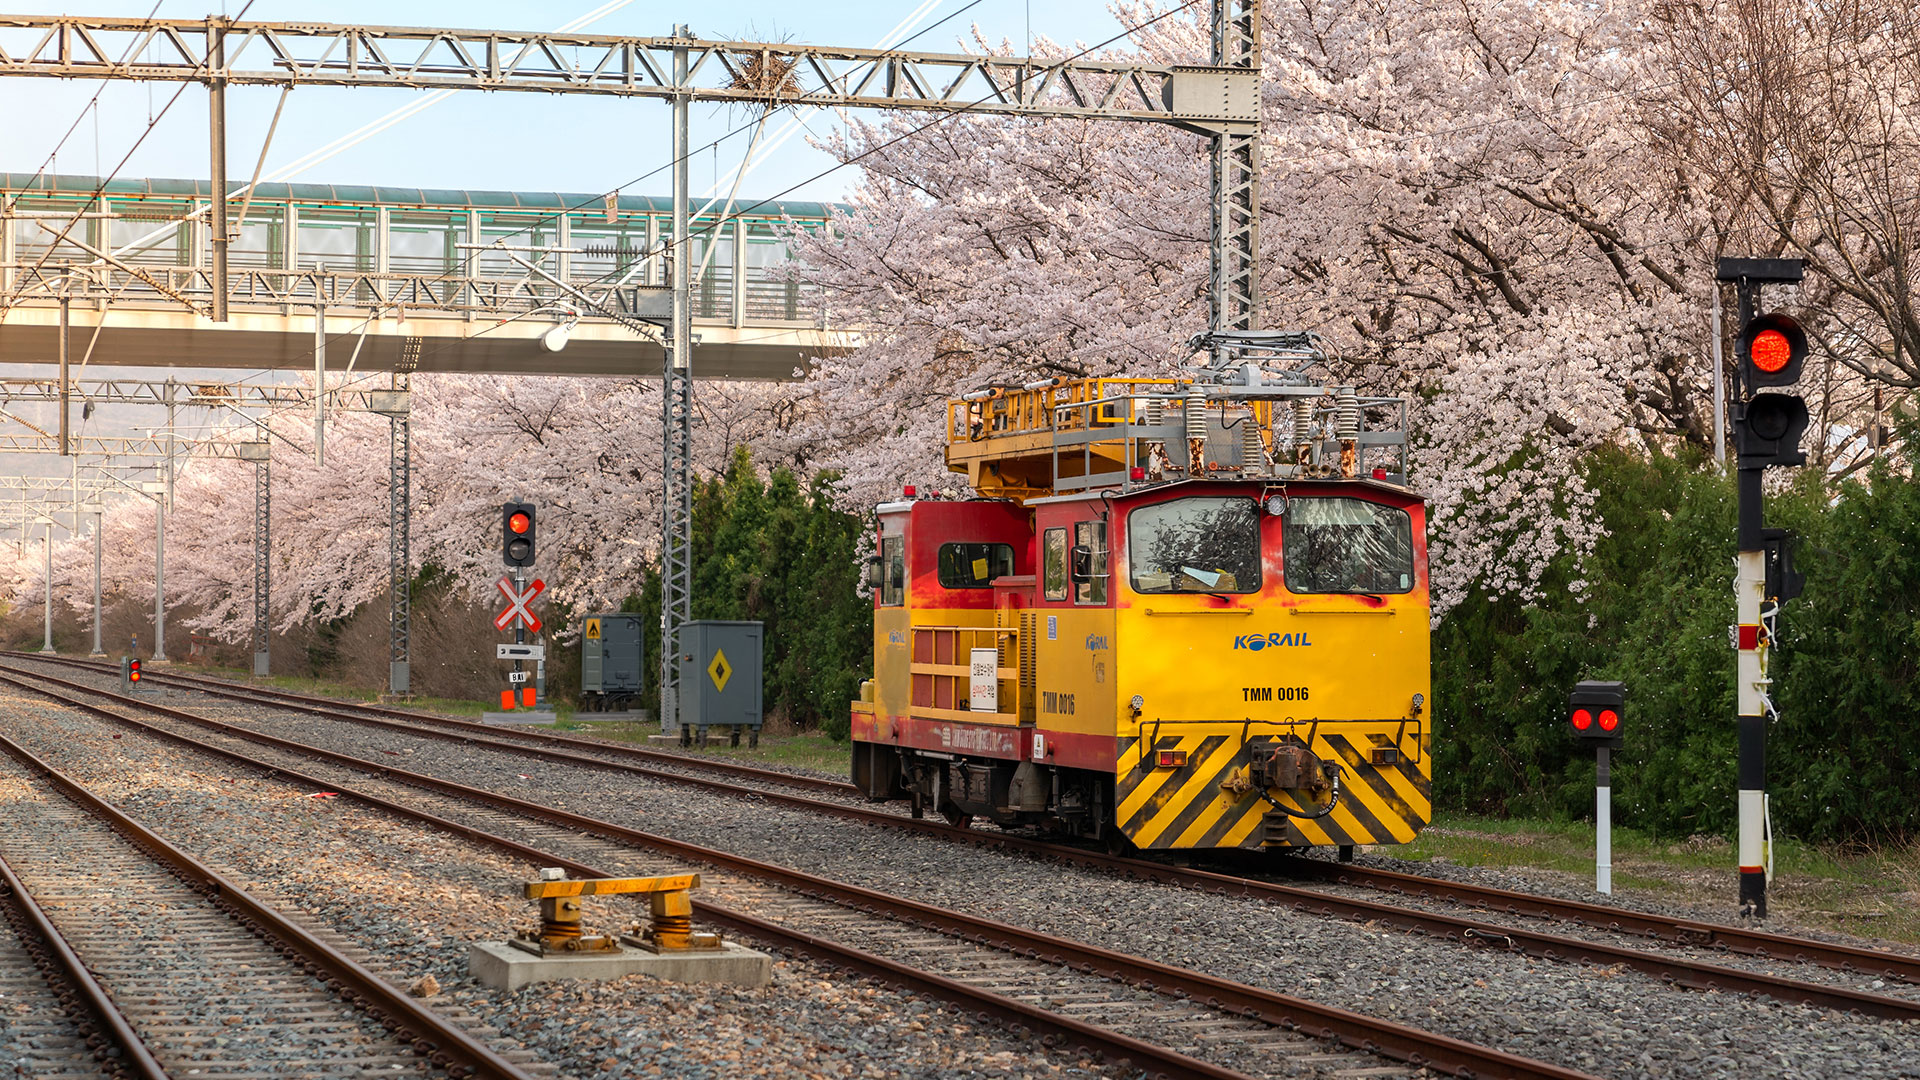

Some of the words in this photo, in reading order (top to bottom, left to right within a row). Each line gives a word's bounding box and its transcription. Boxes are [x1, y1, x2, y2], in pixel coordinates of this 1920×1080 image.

[1085, 633, 1108, 651] KORAIL
[1233, 632, 1312, 651] KORAIL
[1042, 691, 1057, 714] TMM
[1059, 693, 1075, 715] 0016
[1242, 688, 1272, 702] TMM
[1278, 687, 1309, 701] 0016
